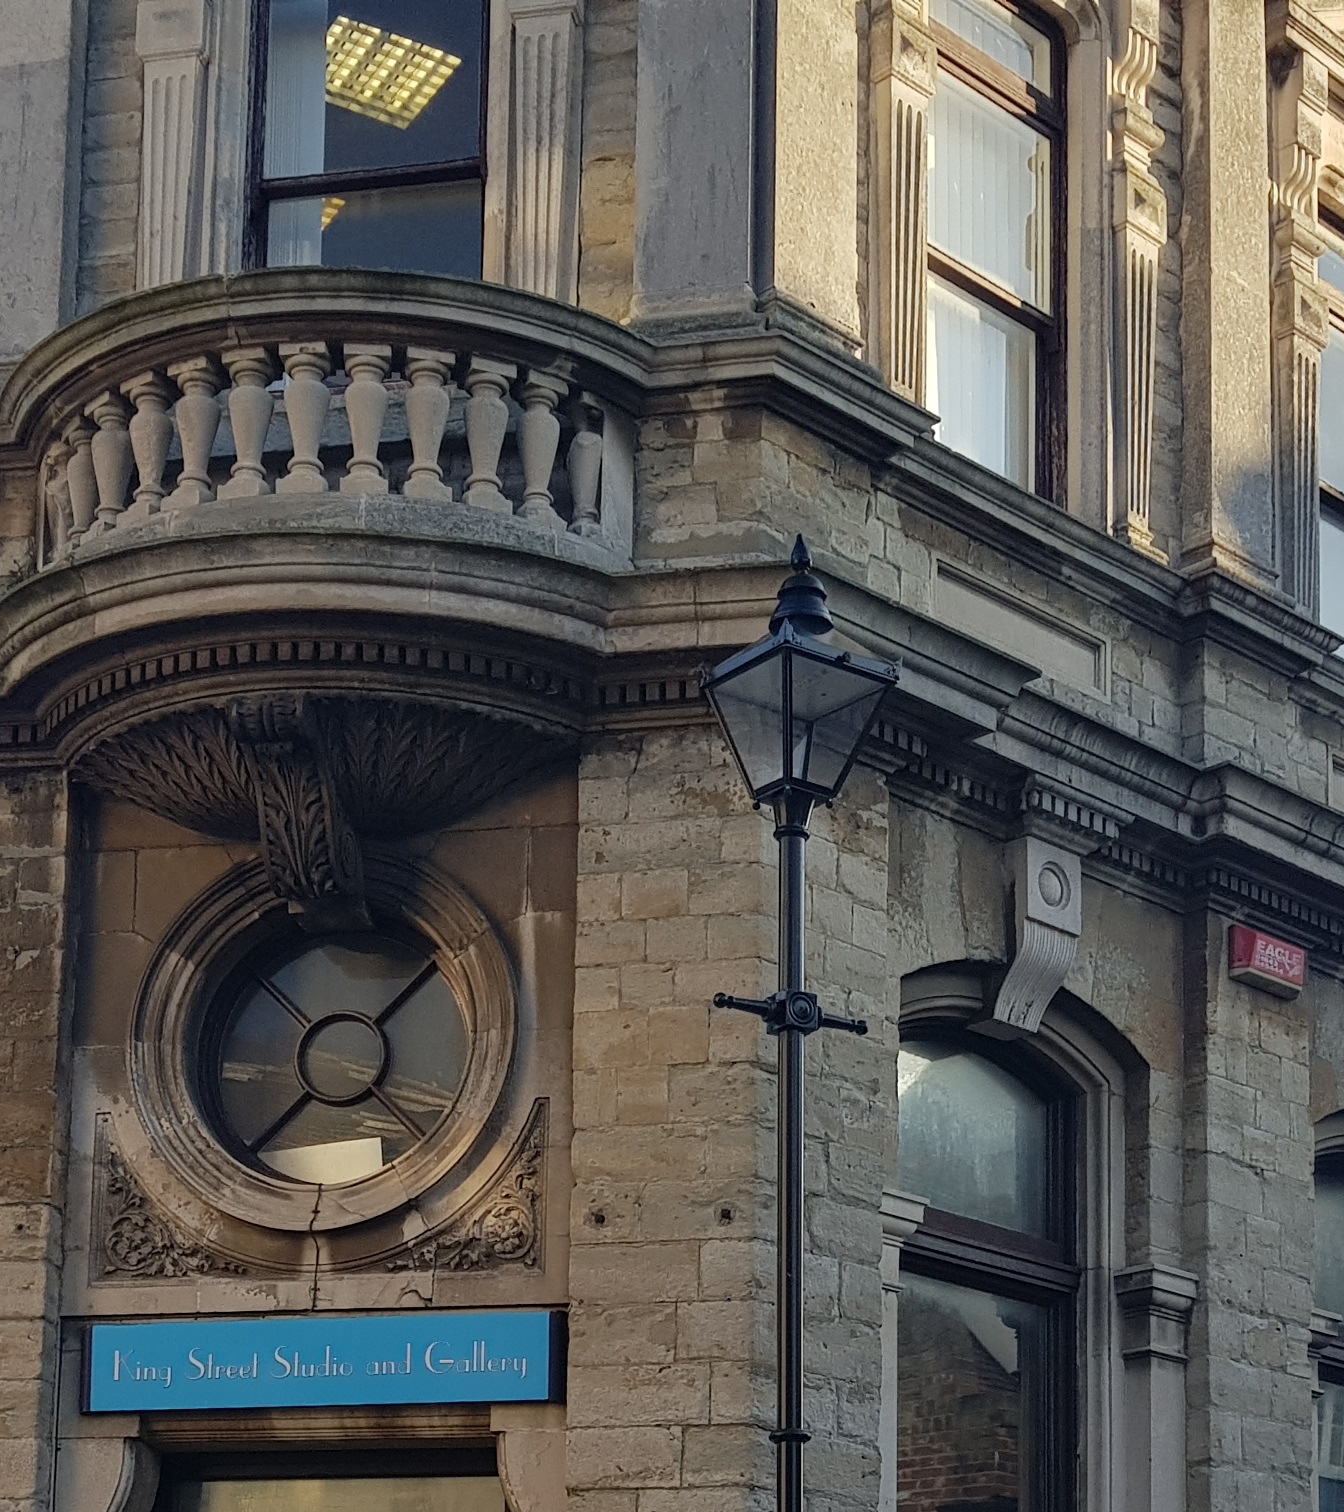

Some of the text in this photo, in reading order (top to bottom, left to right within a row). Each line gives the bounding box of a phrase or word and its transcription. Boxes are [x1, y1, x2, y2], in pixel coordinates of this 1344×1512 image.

[1257, 939, 1302, 965] EAGLE
[113, 1339, 529, 1389] King Street Studio and Gallery
